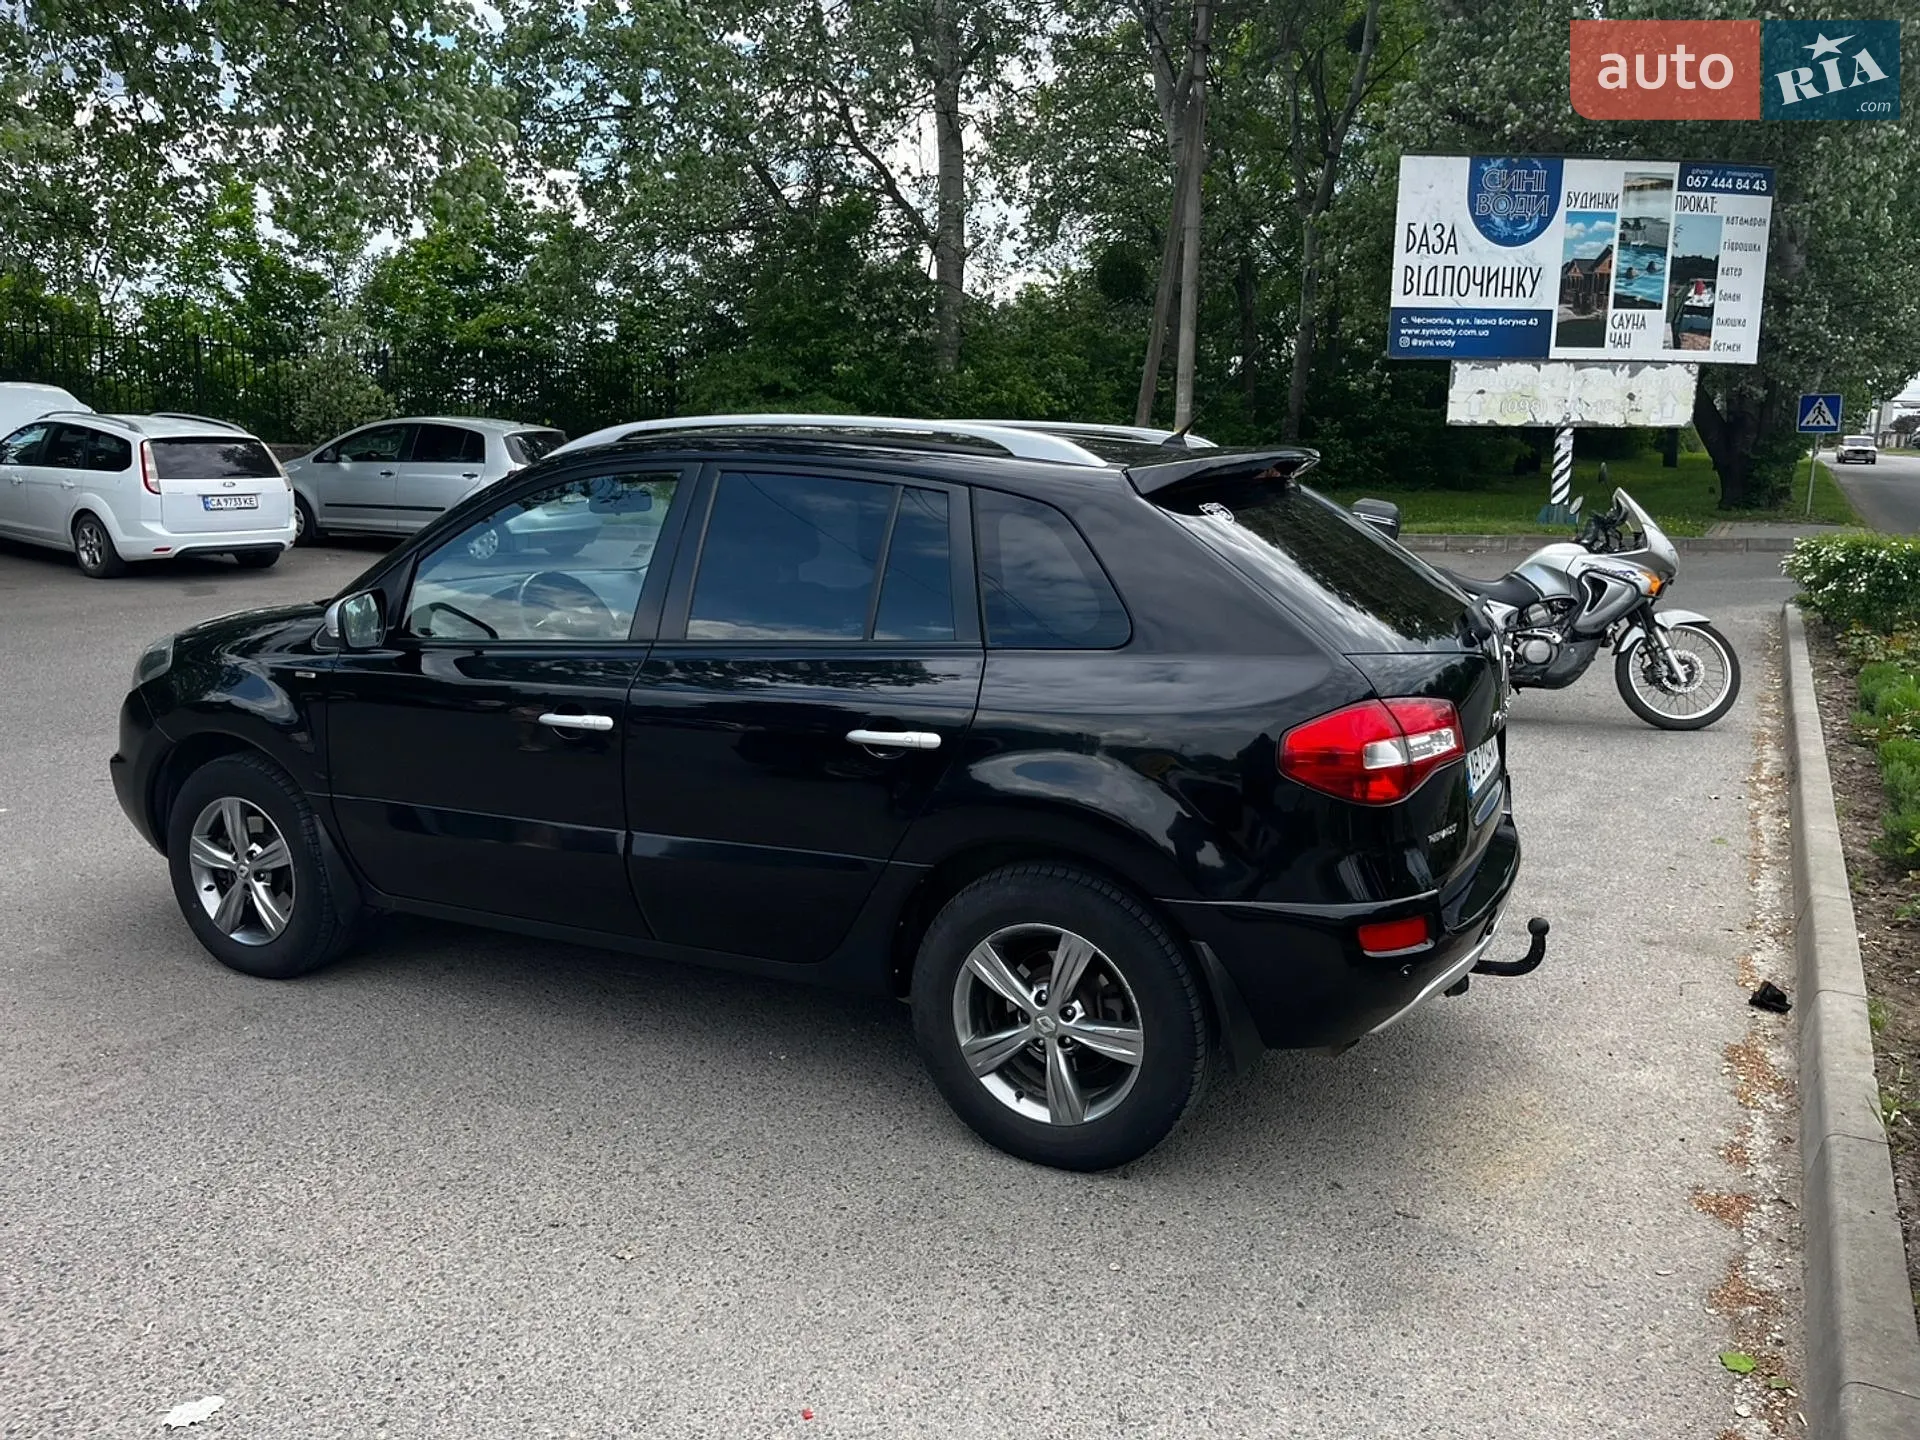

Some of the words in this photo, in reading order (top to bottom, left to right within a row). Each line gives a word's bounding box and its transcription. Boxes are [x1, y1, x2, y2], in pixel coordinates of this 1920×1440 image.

[1482, 168, 1548, 192] СИНІ
[1686, 175, 1709, 188] 067
[1711, 177, 1733, 189] 444
[1735, 178, 1750, 190] 84
[1752, 179, 1767, 192] 43
[1475, 193, 1550, 220] ВОДИ
[1566, 191, 1619, 210] БУДИНКИ
[1675, 194, 1718, 214] ПРОКАТ:
[1405, 222, 1459, 255] БАЗА
[1720, 266, 1743, 277] катер
[1402, 264, 1543, 299] ВІДПОЧИНКУ
[1528, 318, 1538, 326] 43
[1610, 312, 1647, 331] САУНА
[1609, 331, 1632, 349] ЧАН
[1713, 341, 1742, 352] бетмен
